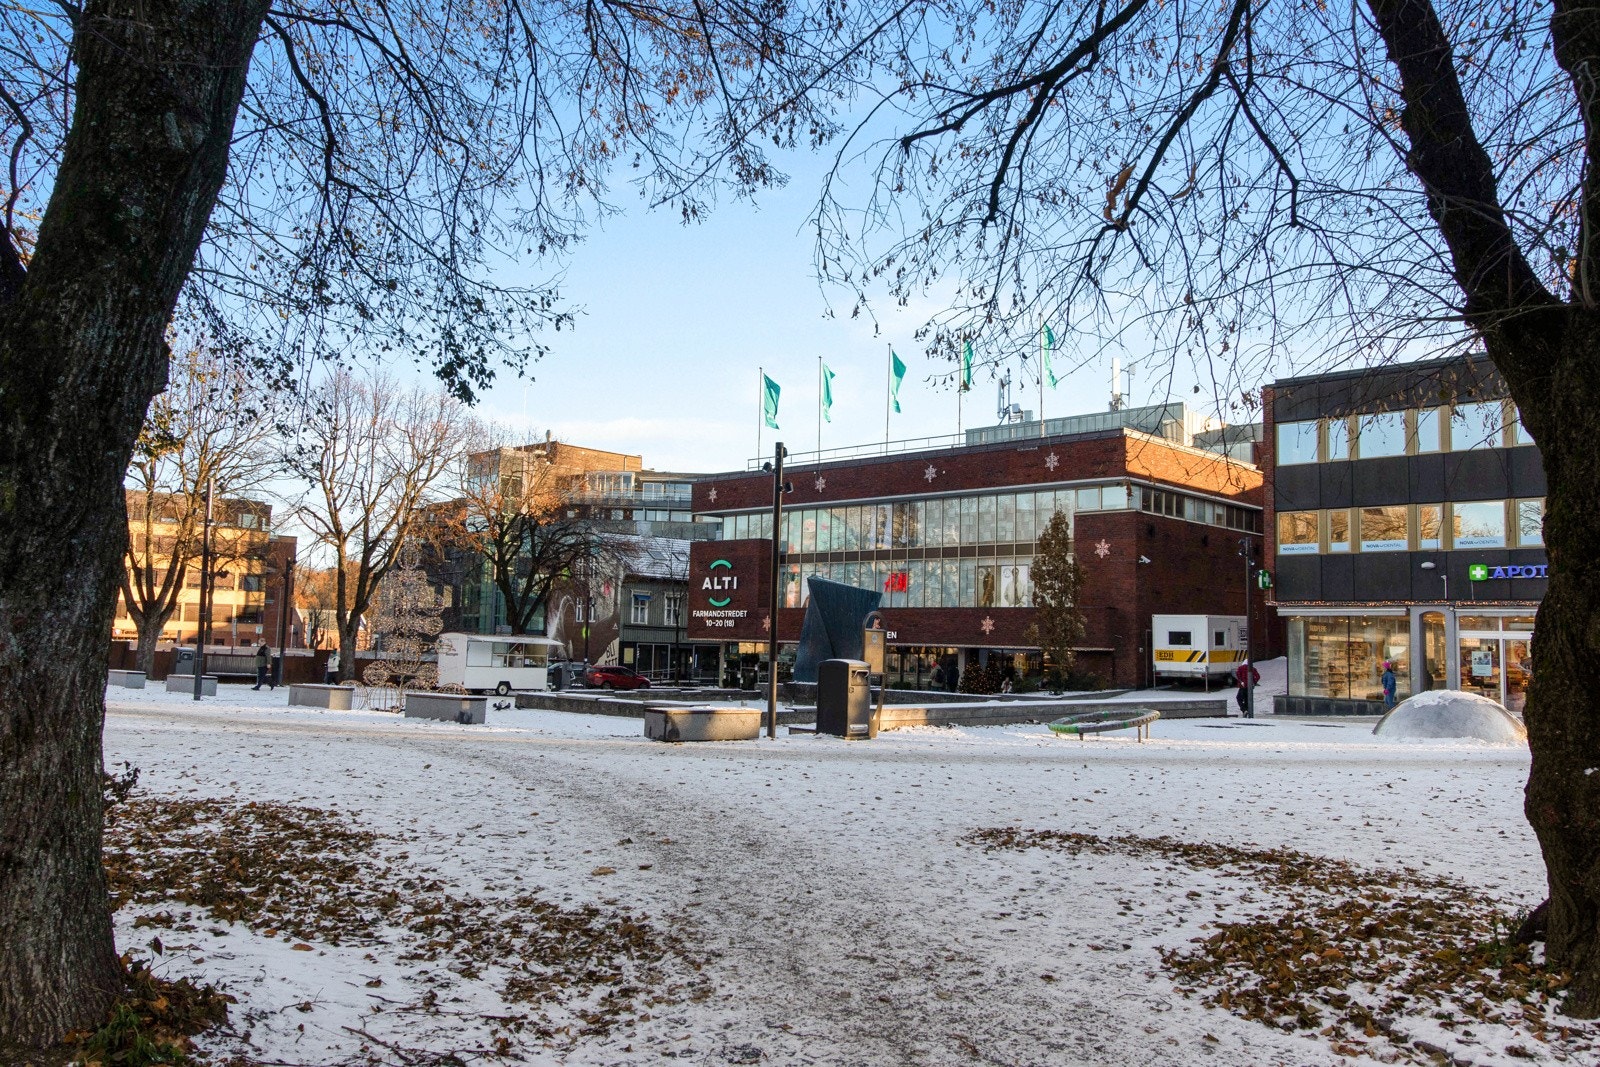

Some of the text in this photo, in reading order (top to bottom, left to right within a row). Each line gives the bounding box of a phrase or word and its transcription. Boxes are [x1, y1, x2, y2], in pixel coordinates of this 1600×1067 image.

[1493, 565, 1548, 579] APOT
[702, 576, 737, 590] ALTI
[692, 610, 747, 618] FARMANDSTREDET
[724, 619, 735, 628] (18)
[886, 631, 897, 639] EN
